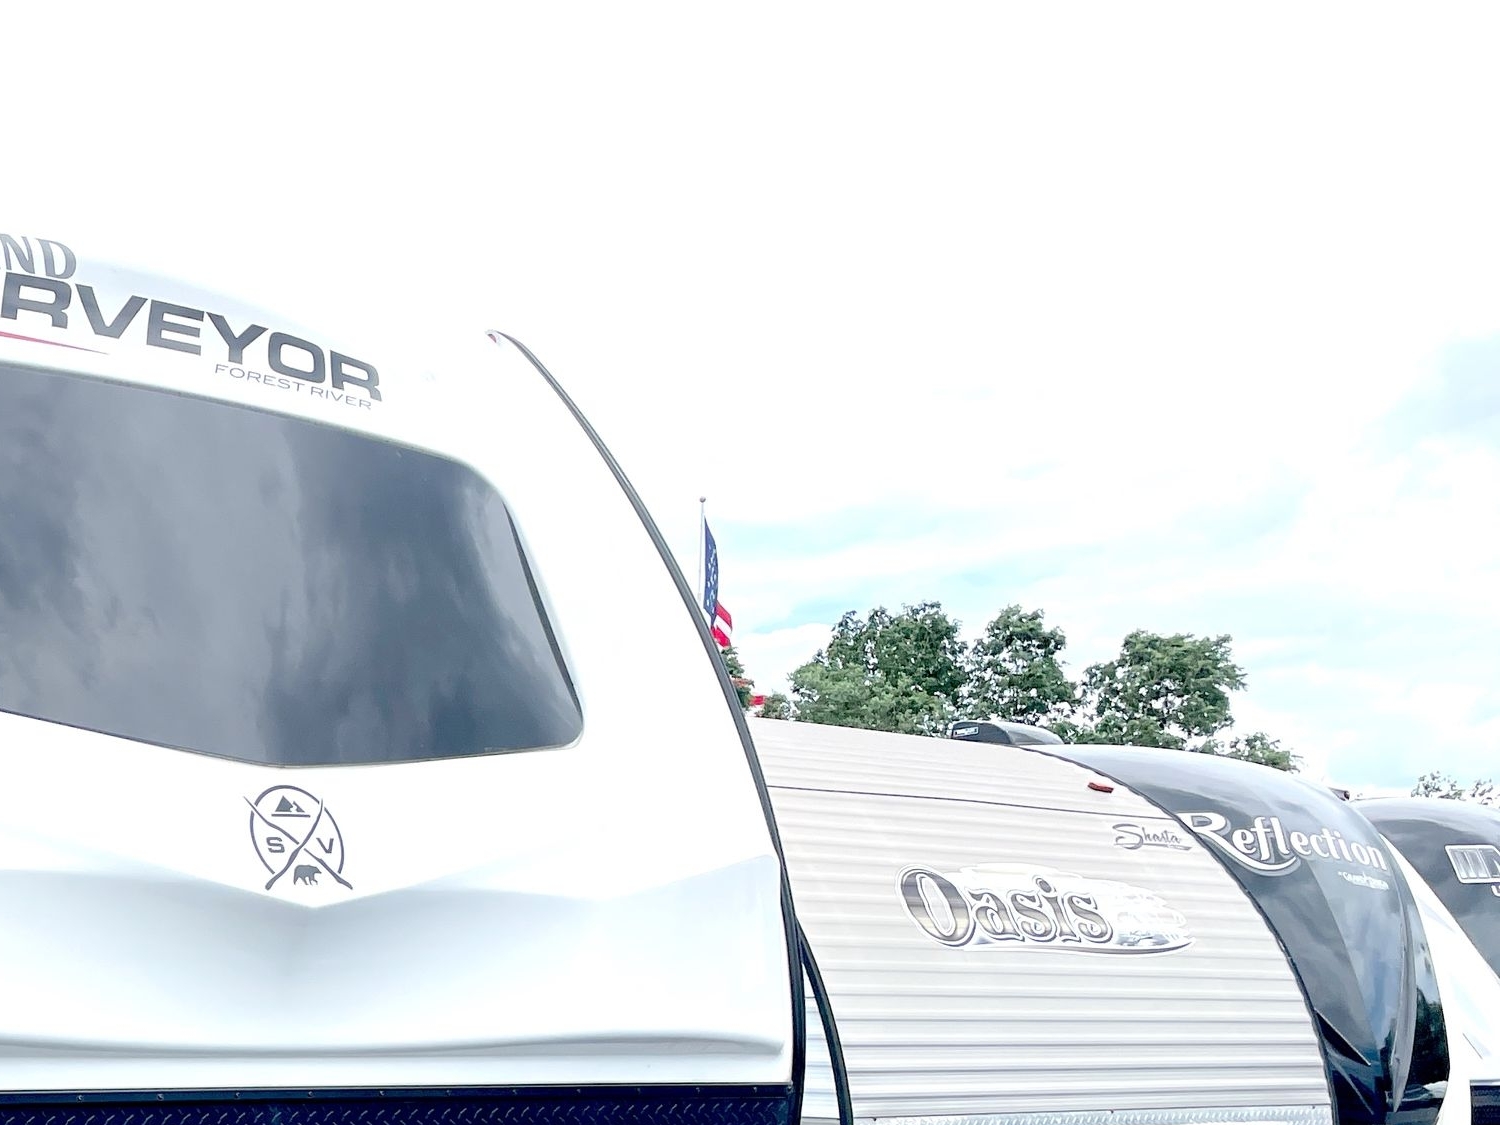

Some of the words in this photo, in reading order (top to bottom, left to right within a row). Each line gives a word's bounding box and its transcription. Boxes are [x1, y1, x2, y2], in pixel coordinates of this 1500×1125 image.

[214, 363, 305, 392] FOREST
[310, 386, 373, 411] RIVER
[1175, 811, 1388, 872] Reflection
[898, 867, 1113, 947] Oasis
